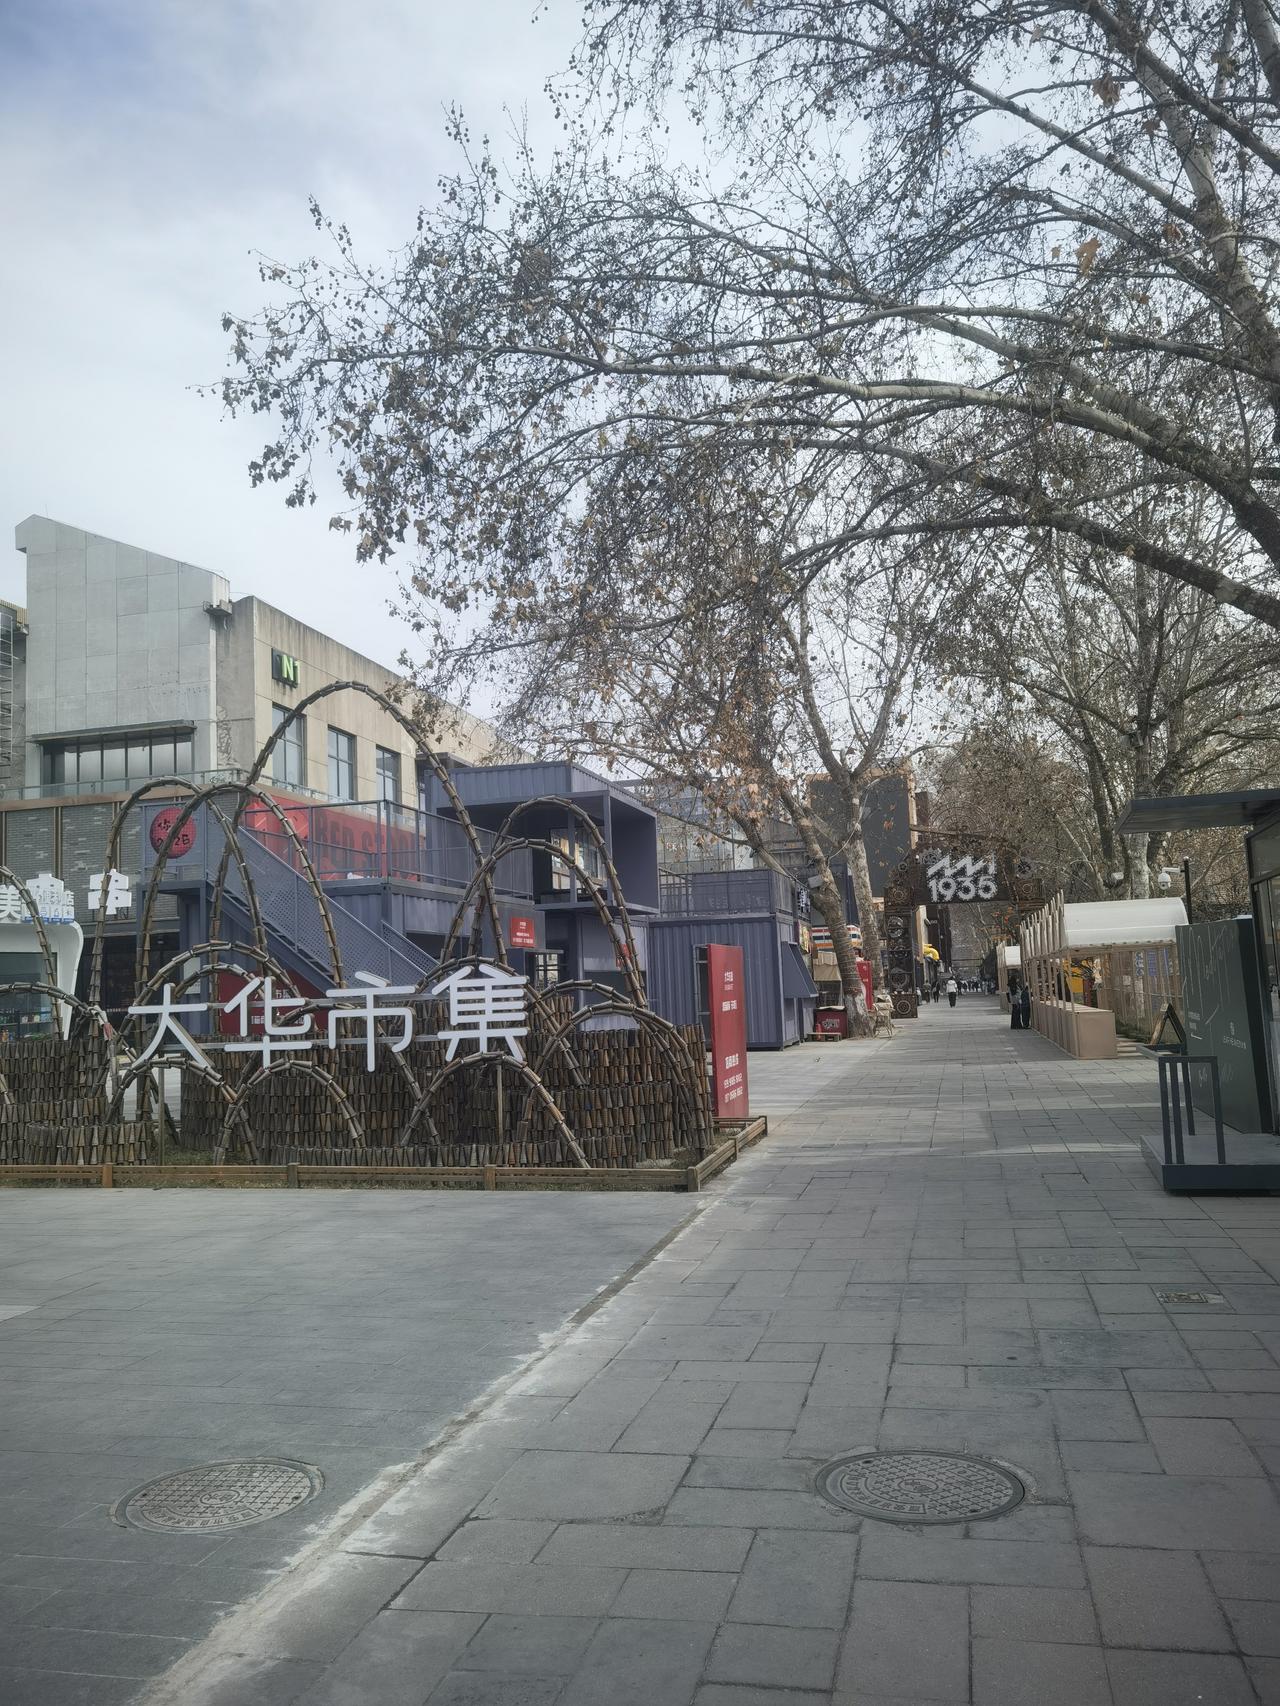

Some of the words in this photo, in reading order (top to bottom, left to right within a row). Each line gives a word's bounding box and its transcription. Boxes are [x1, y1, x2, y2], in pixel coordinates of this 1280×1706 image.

[928, 875, 998, 903] 1935
[128, 964, 528, 1073] 大华市集
